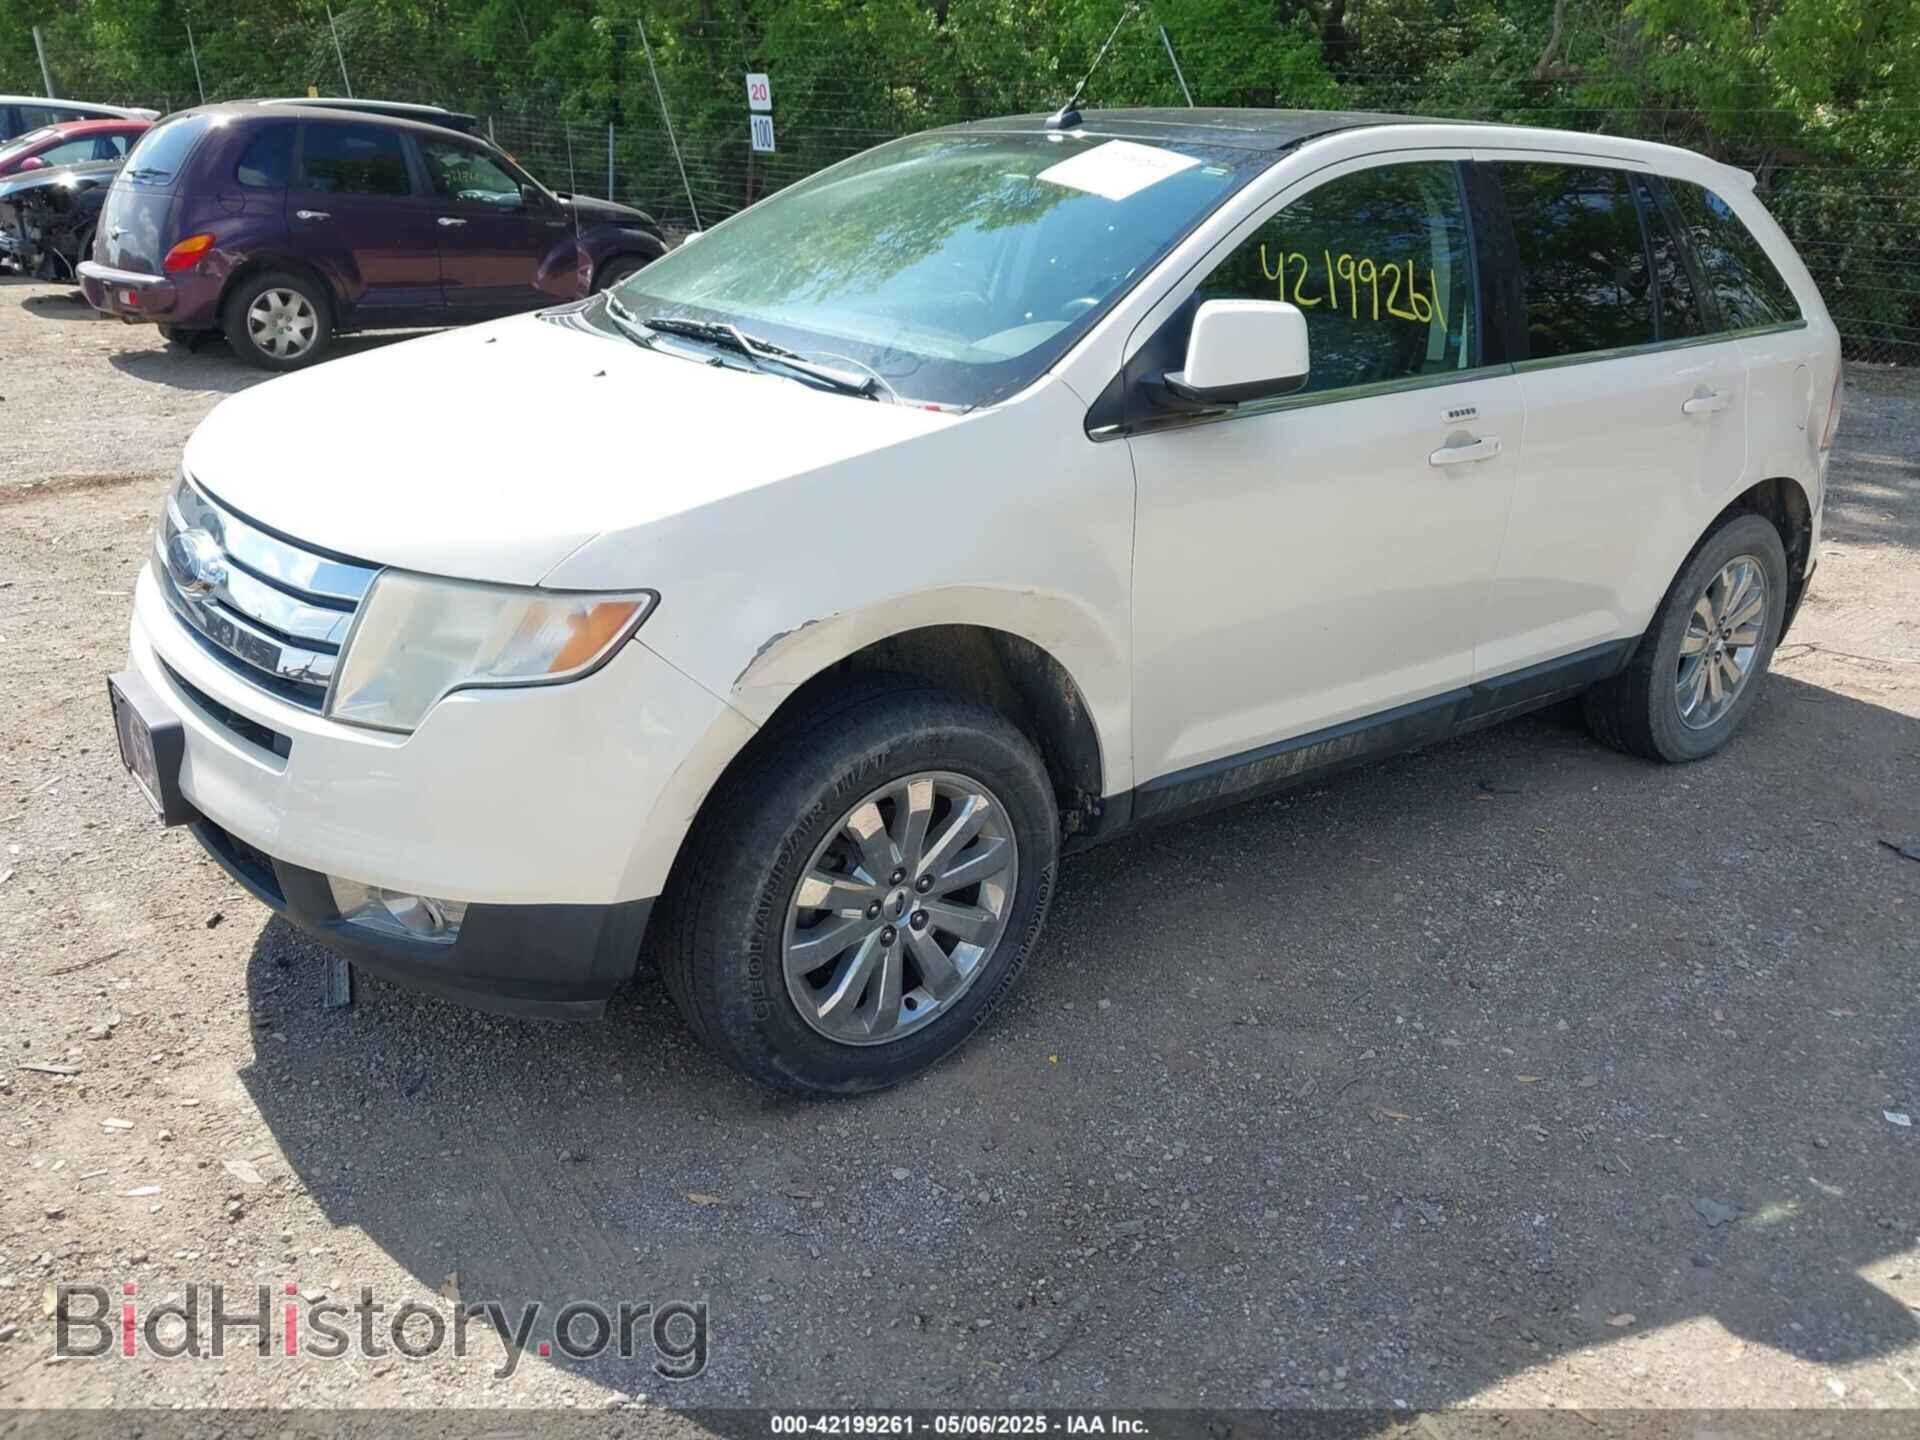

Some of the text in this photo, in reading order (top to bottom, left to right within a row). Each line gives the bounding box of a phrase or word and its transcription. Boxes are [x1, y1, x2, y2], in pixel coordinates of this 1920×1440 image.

[752, 84, 767, 101] 20
[753, 119, 772, 148] 100
[1259, 243, 1448, 332] 42199261
